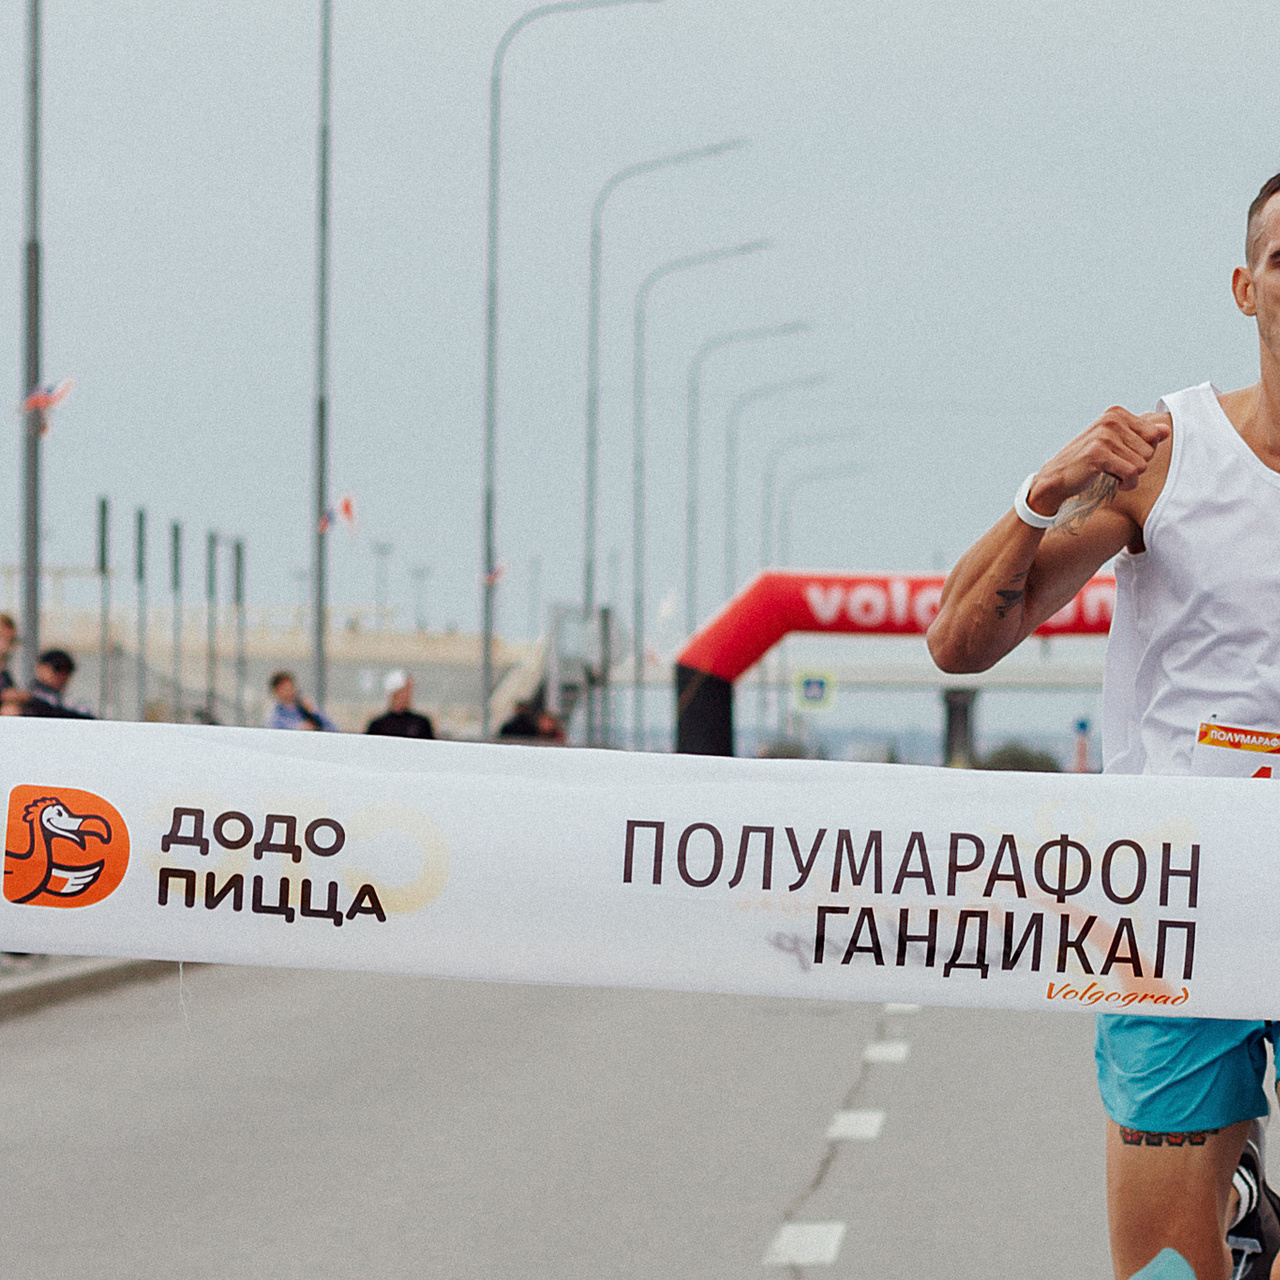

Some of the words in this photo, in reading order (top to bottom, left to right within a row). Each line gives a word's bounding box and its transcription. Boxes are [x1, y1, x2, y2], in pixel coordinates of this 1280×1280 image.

[160, 807, 347, 864] ДОДО
[622, 819, 1202, 909] ПОЛУМАРАФОН
[156, 867, 388, 927] ПИЦЦА
[811, 905, 1199, 981] ГАНДИКАП
[1044, 980, 1190, 1008] Volgograd
